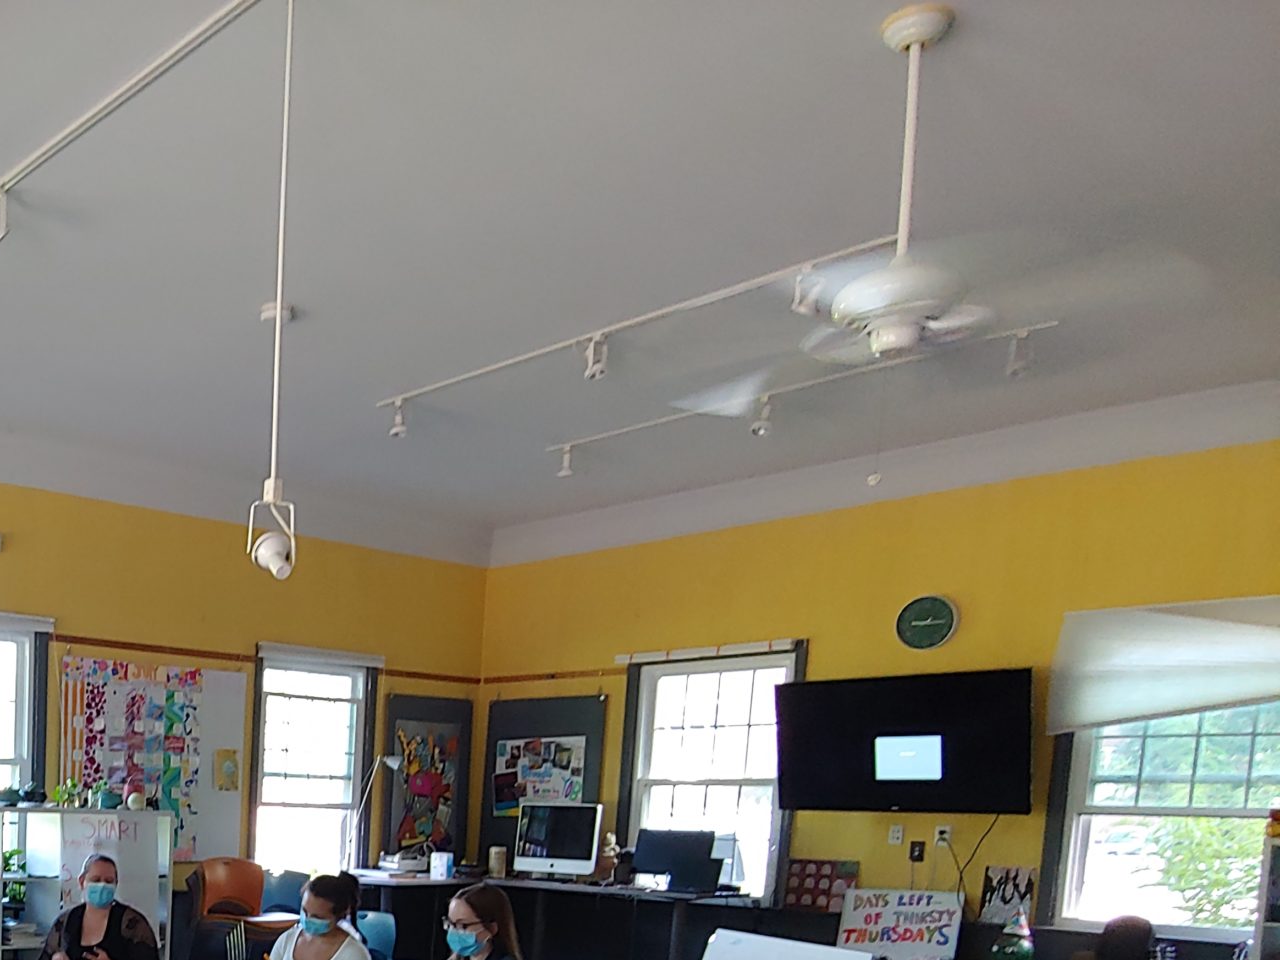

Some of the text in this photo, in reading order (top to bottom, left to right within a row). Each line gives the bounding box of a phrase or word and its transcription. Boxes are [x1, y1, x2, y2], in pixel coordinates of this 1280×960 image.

[81, 816, 140, 842] SMART
[853, 893, 890, 911] DAYS
[864, 908, 957, 926] OF THIRSTY
[842, 924, 952, 946] THURSDAYS
